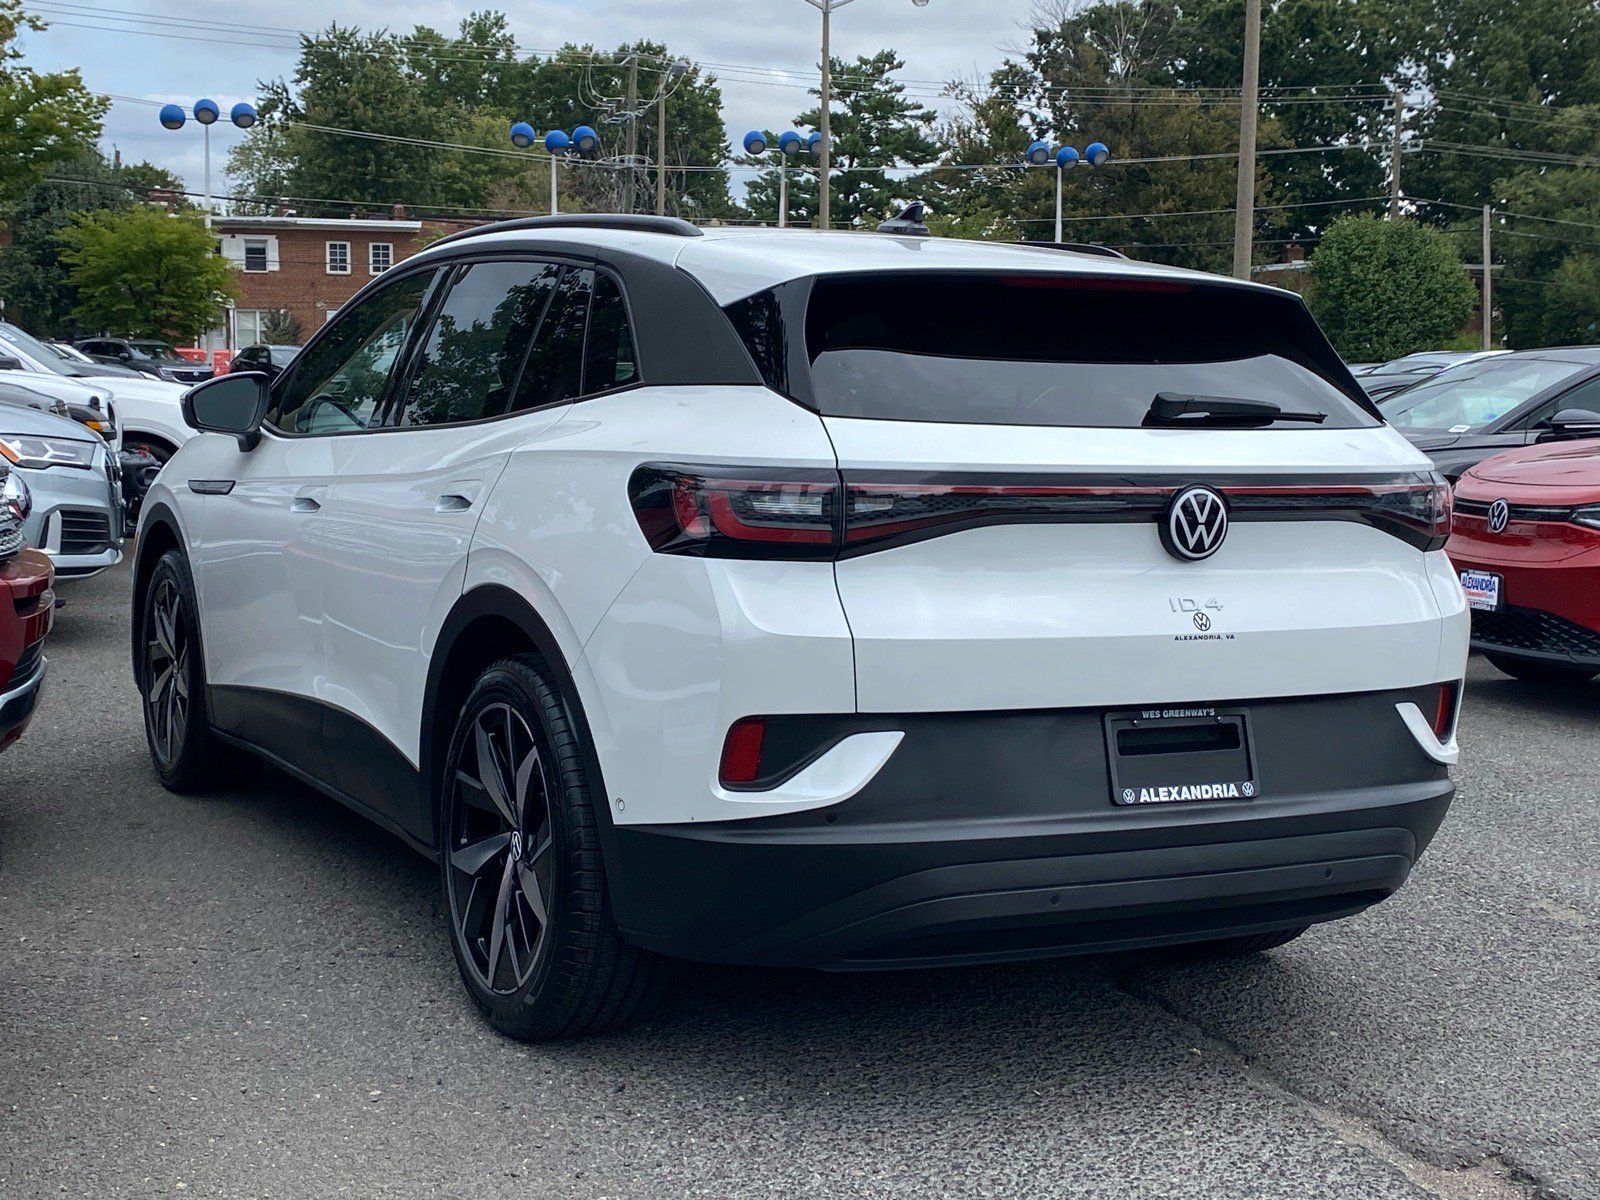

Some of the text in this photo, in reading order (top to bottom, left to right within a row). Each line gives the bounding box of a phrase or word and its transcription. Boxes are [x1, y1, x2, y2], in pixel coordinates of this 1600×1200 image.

[1461, 575, 1496, 592] ALEXANDRIA
[1142, 708, 1215, 719] WES GREENWAY'S
[1139, 783, 1239, 803] ALEXANDRIA
